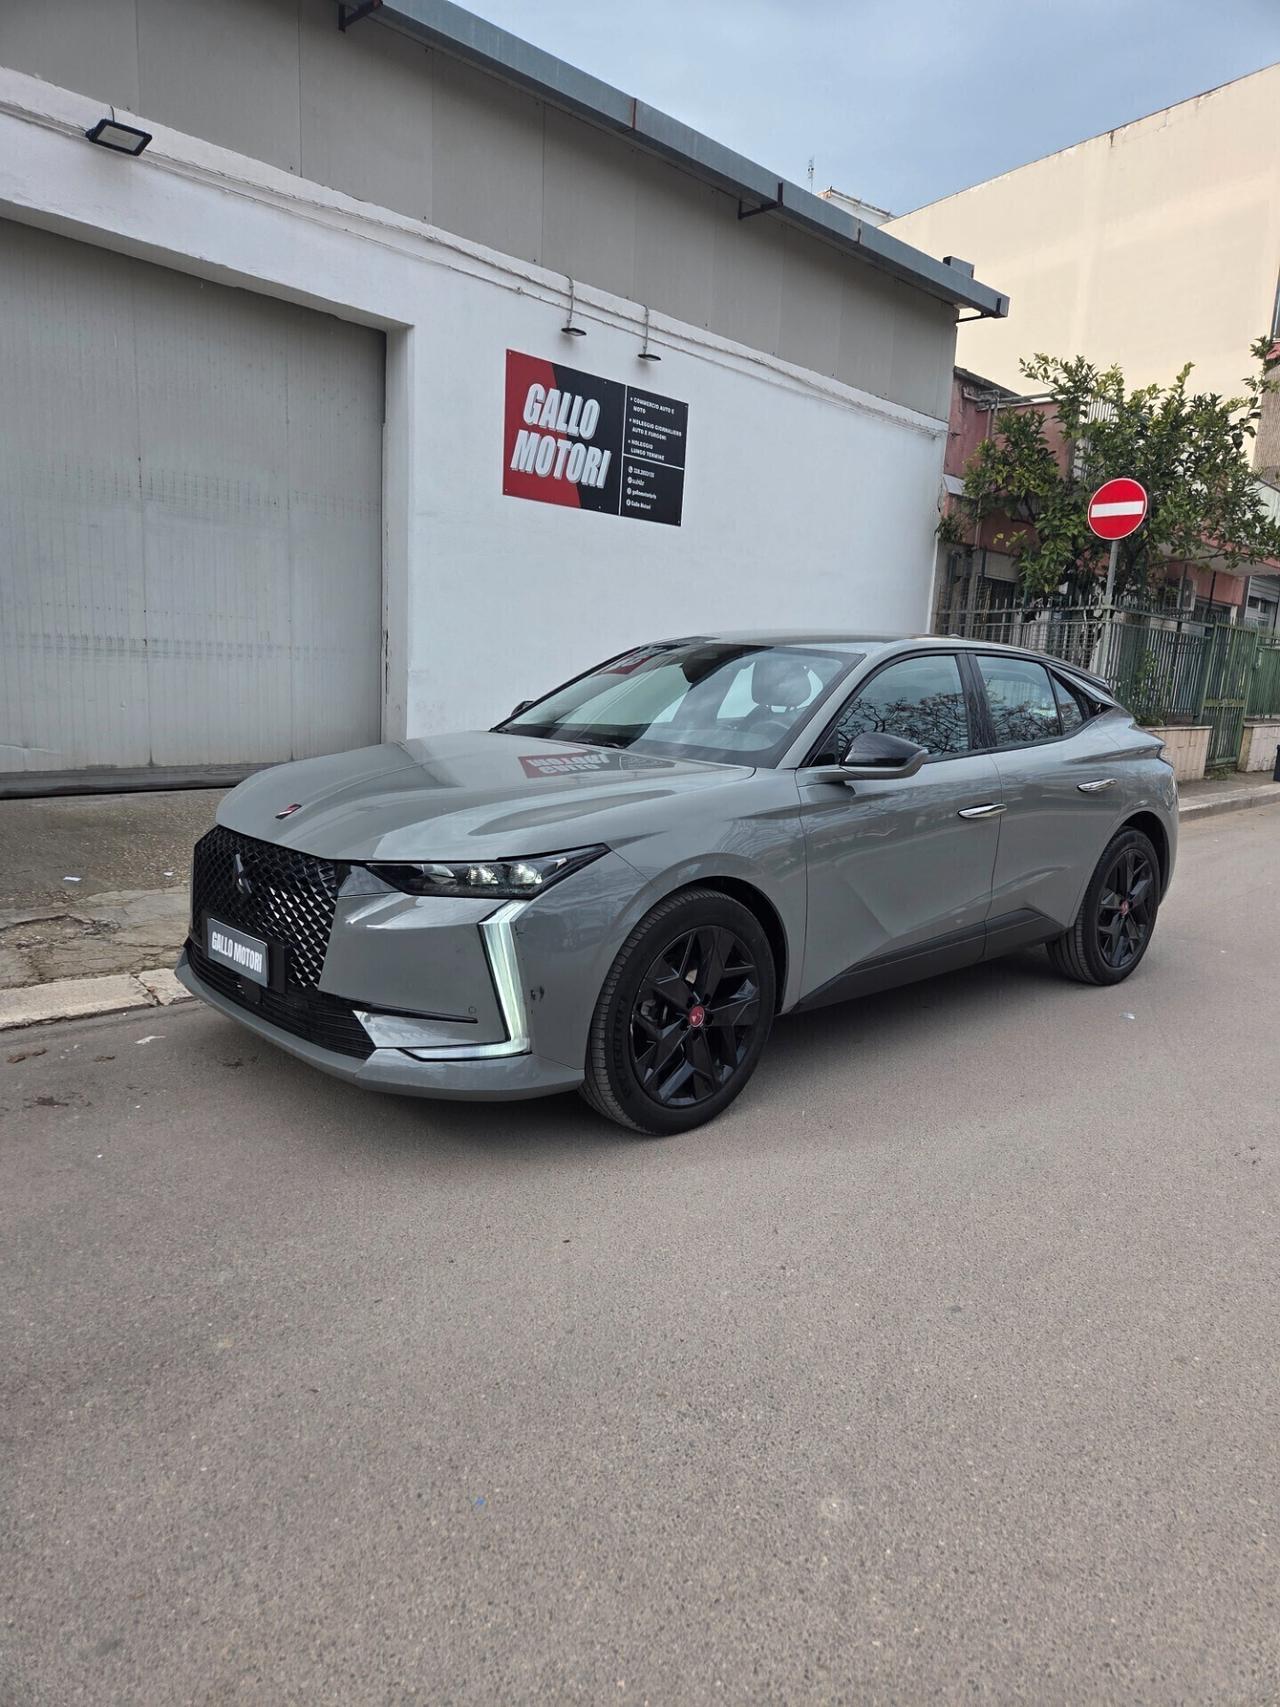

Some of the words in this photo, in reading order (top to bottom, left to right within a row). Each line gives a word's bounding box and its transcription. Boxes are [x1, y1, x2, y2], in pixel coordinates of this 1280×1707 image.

[523, 383, 600, 440] GALLO
[634, 397, 659, 409] COMMERCIO
[660, 405, 671, 414] AUTO
[632, 418, 654, 429] NOLEGGIO
[510, 429, 612, 489] MOTORI
[631, 440, 653, 449] NOLEGGIO
[212, 931, 233, 958] GALLO
[233, 942, 263, 973] MOTORI
